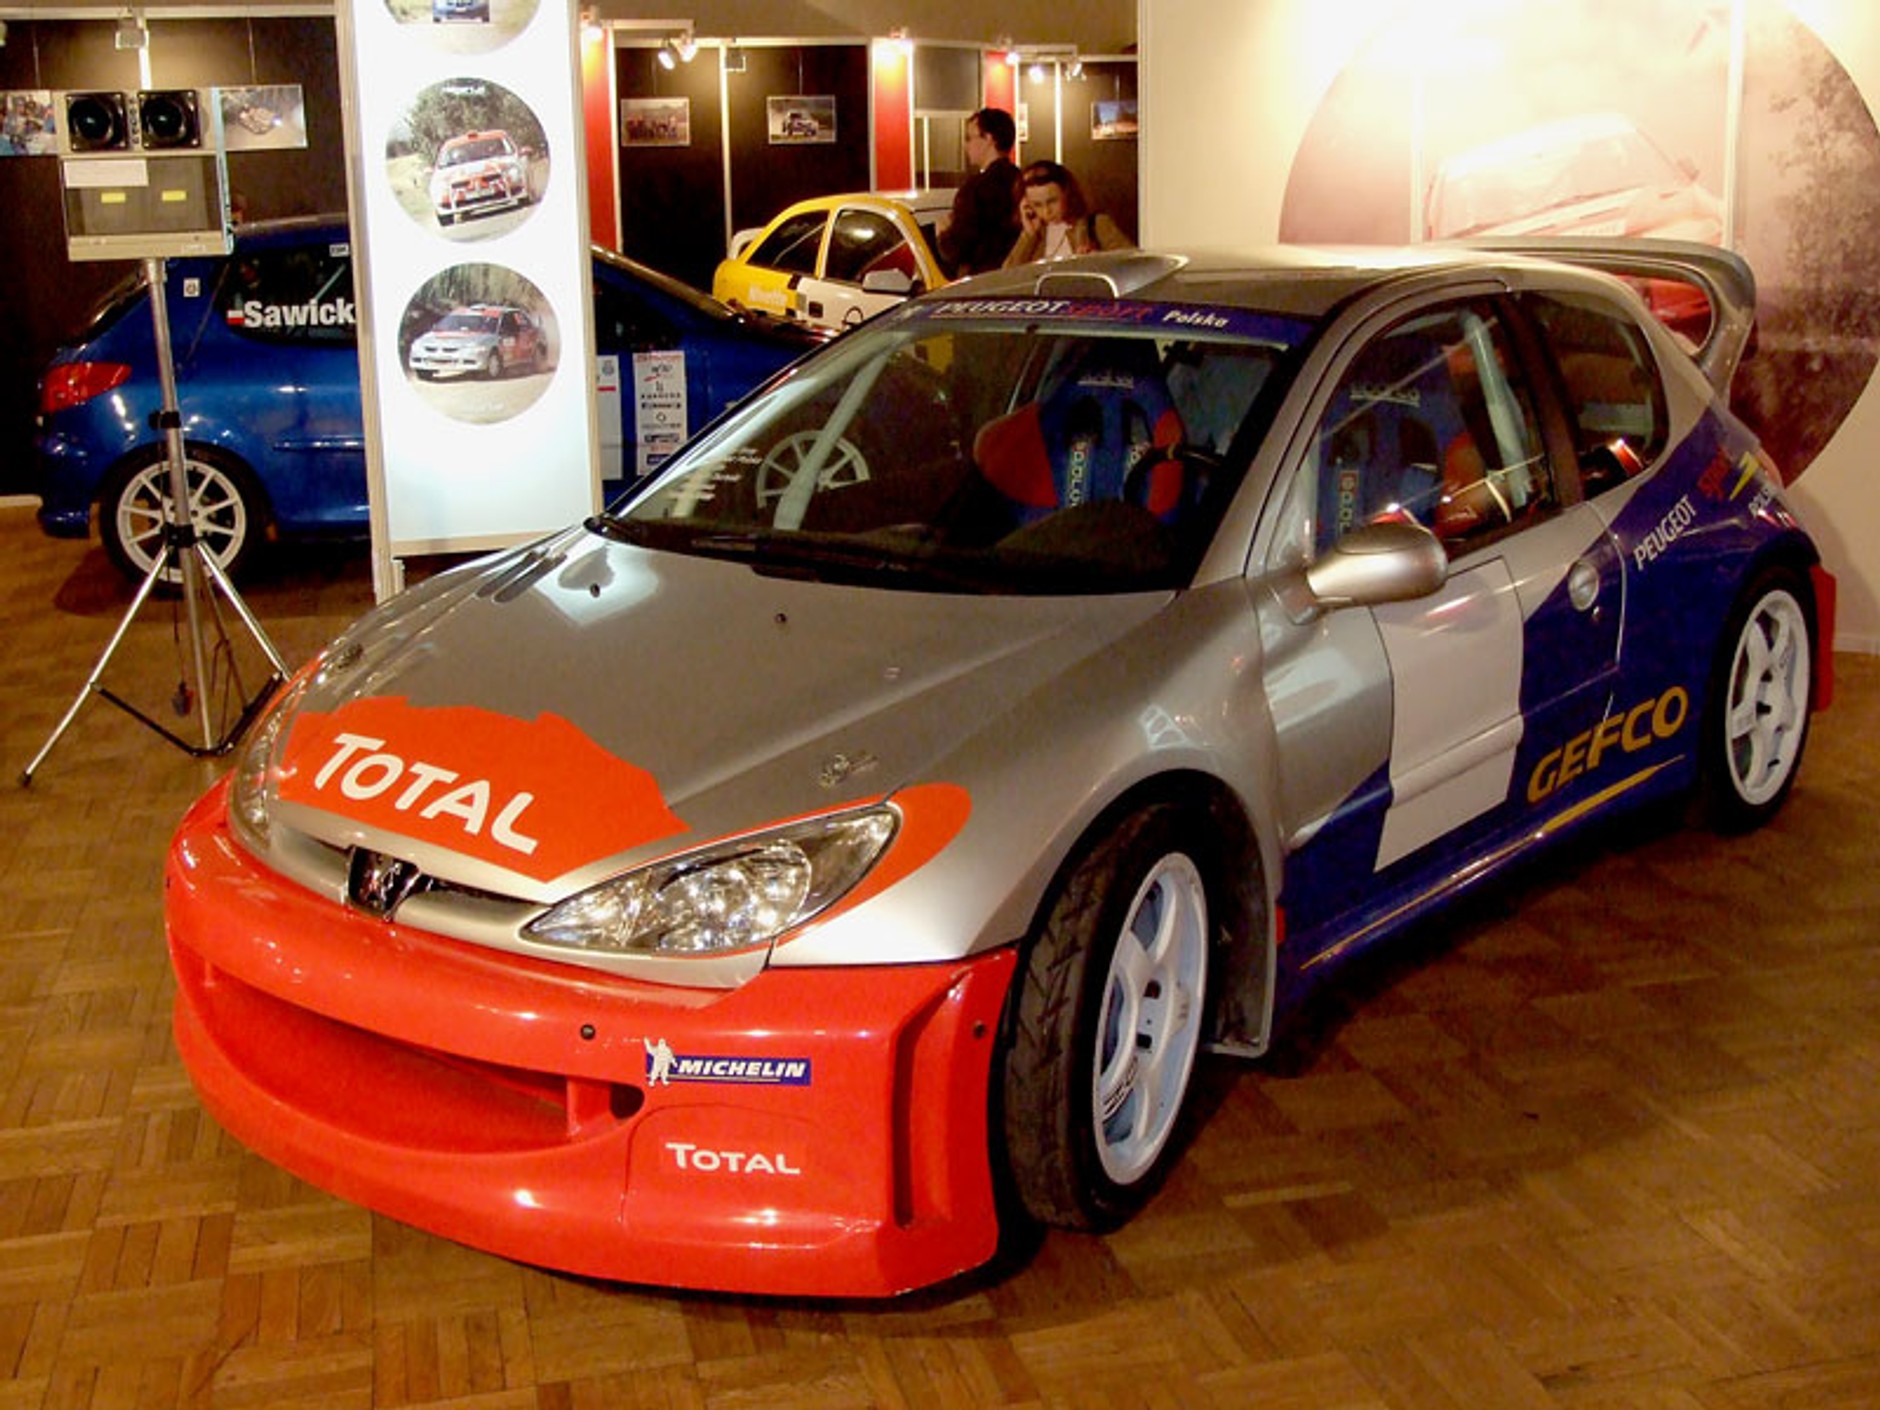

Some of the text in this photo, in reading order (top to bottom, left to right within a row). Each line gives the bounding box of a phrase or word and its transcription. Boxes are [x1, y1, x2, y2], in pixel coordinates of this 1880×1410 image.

[936, 300, 1069, 314] PEUGEOT
[1162, 310, 1229, 328] Polska
[1633, 494, 1697, 571] PEUGEOT
[1527, 686, 1689, 803] GEFCO
[314, 732, 539, 856] TOTAL
[678, 1059, 806, 1078] MICHELIN
[665, 1142, 800, 1175] TOTAL
